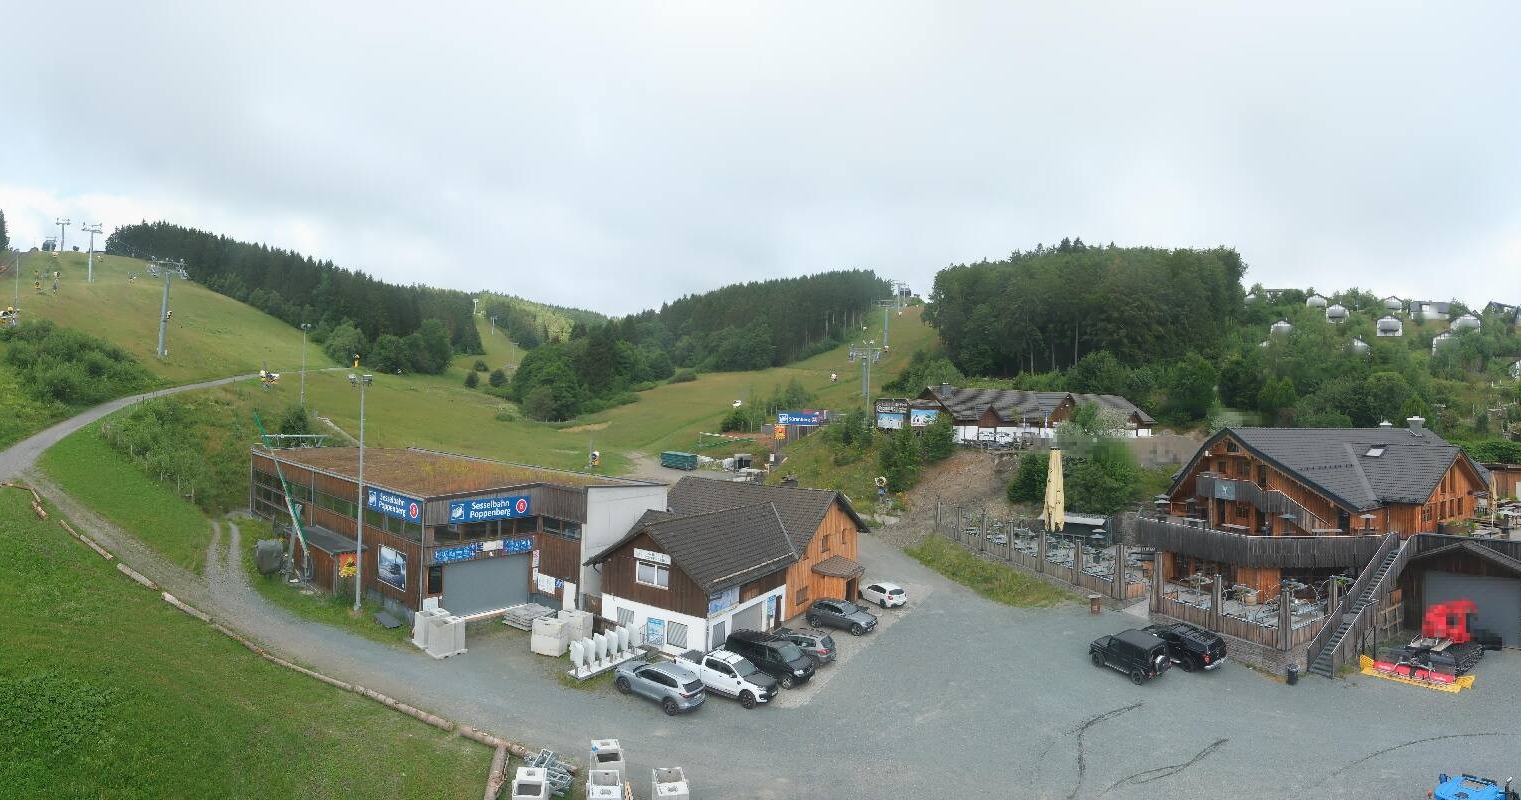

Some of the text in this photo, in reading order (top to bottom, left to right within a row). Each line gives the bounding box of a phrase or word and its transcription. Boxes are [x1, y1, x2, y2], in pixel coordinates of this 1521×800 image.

[379, 492, 405, 506] Sesselbahn
[471, 499, 510, 510] Sesselbahn
[378, 500, 406, 518] Poppenberg
[469, 507, 511, 520] Poppenberg
